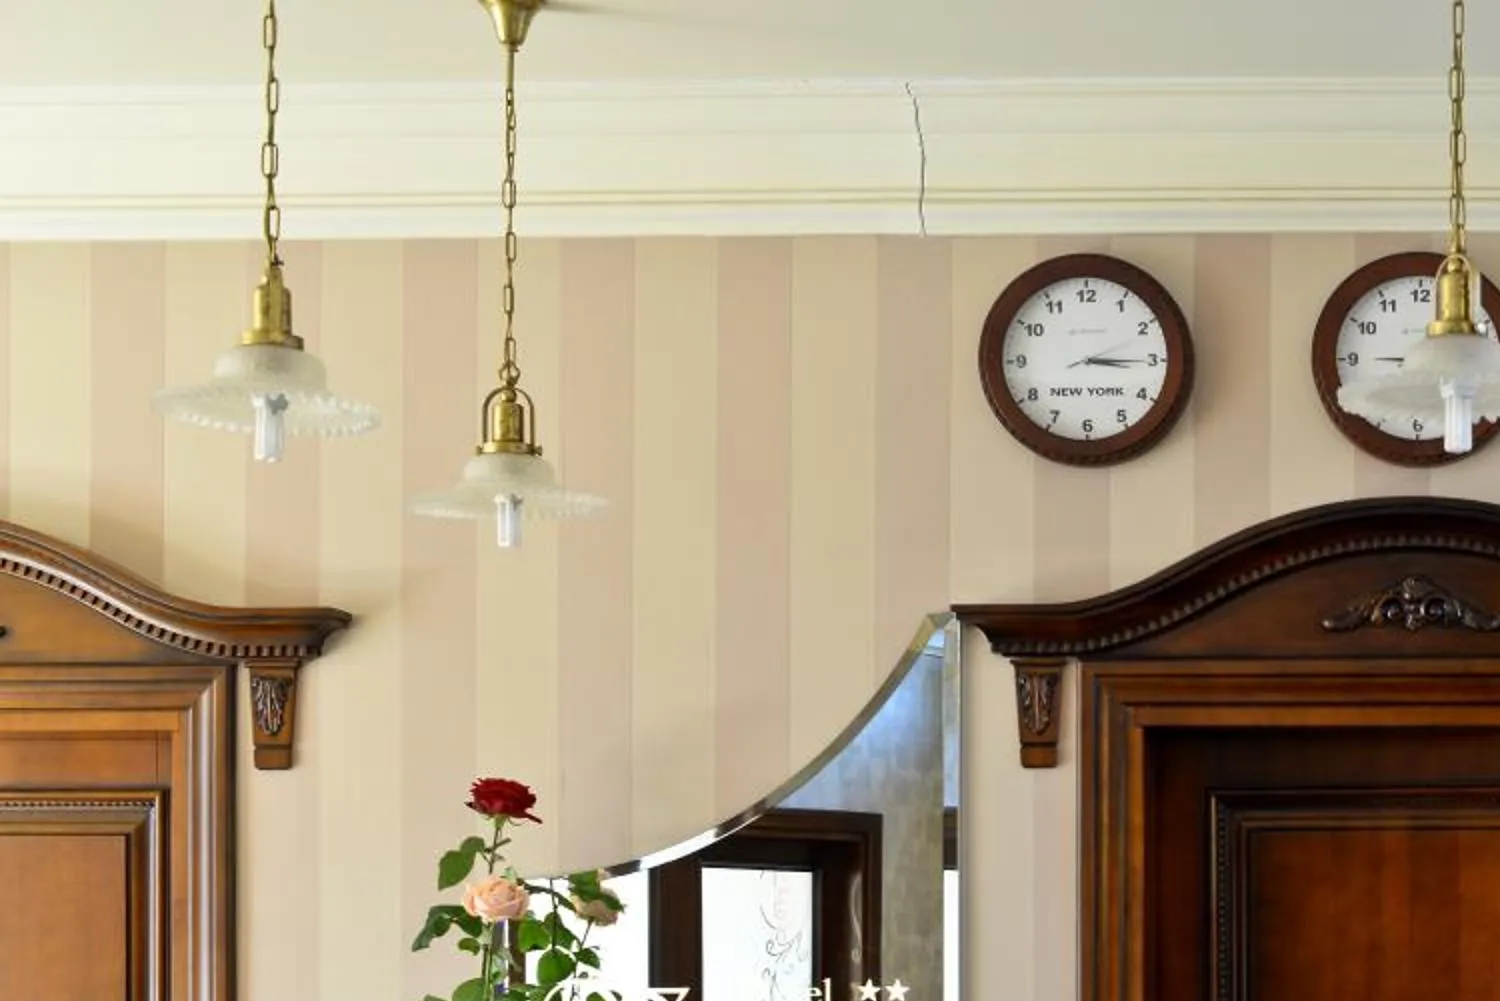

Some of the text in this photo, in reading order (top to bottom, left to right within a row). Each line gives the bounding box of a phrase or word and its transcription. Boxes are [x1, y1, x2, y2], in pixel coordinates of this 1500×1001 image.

[1076, 289, 1097, 303] 12
[1410, 289, 1431, 303] 12
[1046, 300, 1063, 314] 11
[1116, 299, 1125, 313] 1
[1379, 300, 1397, 313] 11
[1025, 323, 1045, 337] 10
[1138, 322, 1149, 336] 2
[1358, 322, 1377, 335] 10
[1016, 355, 1027, 368] 9
[1148, 353, 1158, 367] 3
[1347, 353, 1359, 366] 9
[1028, 388, 1039, 401] 8
[1050, 387, 1124, 397] NEW YORK
[1136, 387, 1148, 401] 4
[1050, 410, 1060, 423] 7
[1117, 410, 1127, 423] 5
[1083, 419, 1093, 432] 6
[1413, 419, 1424, 432] 6
